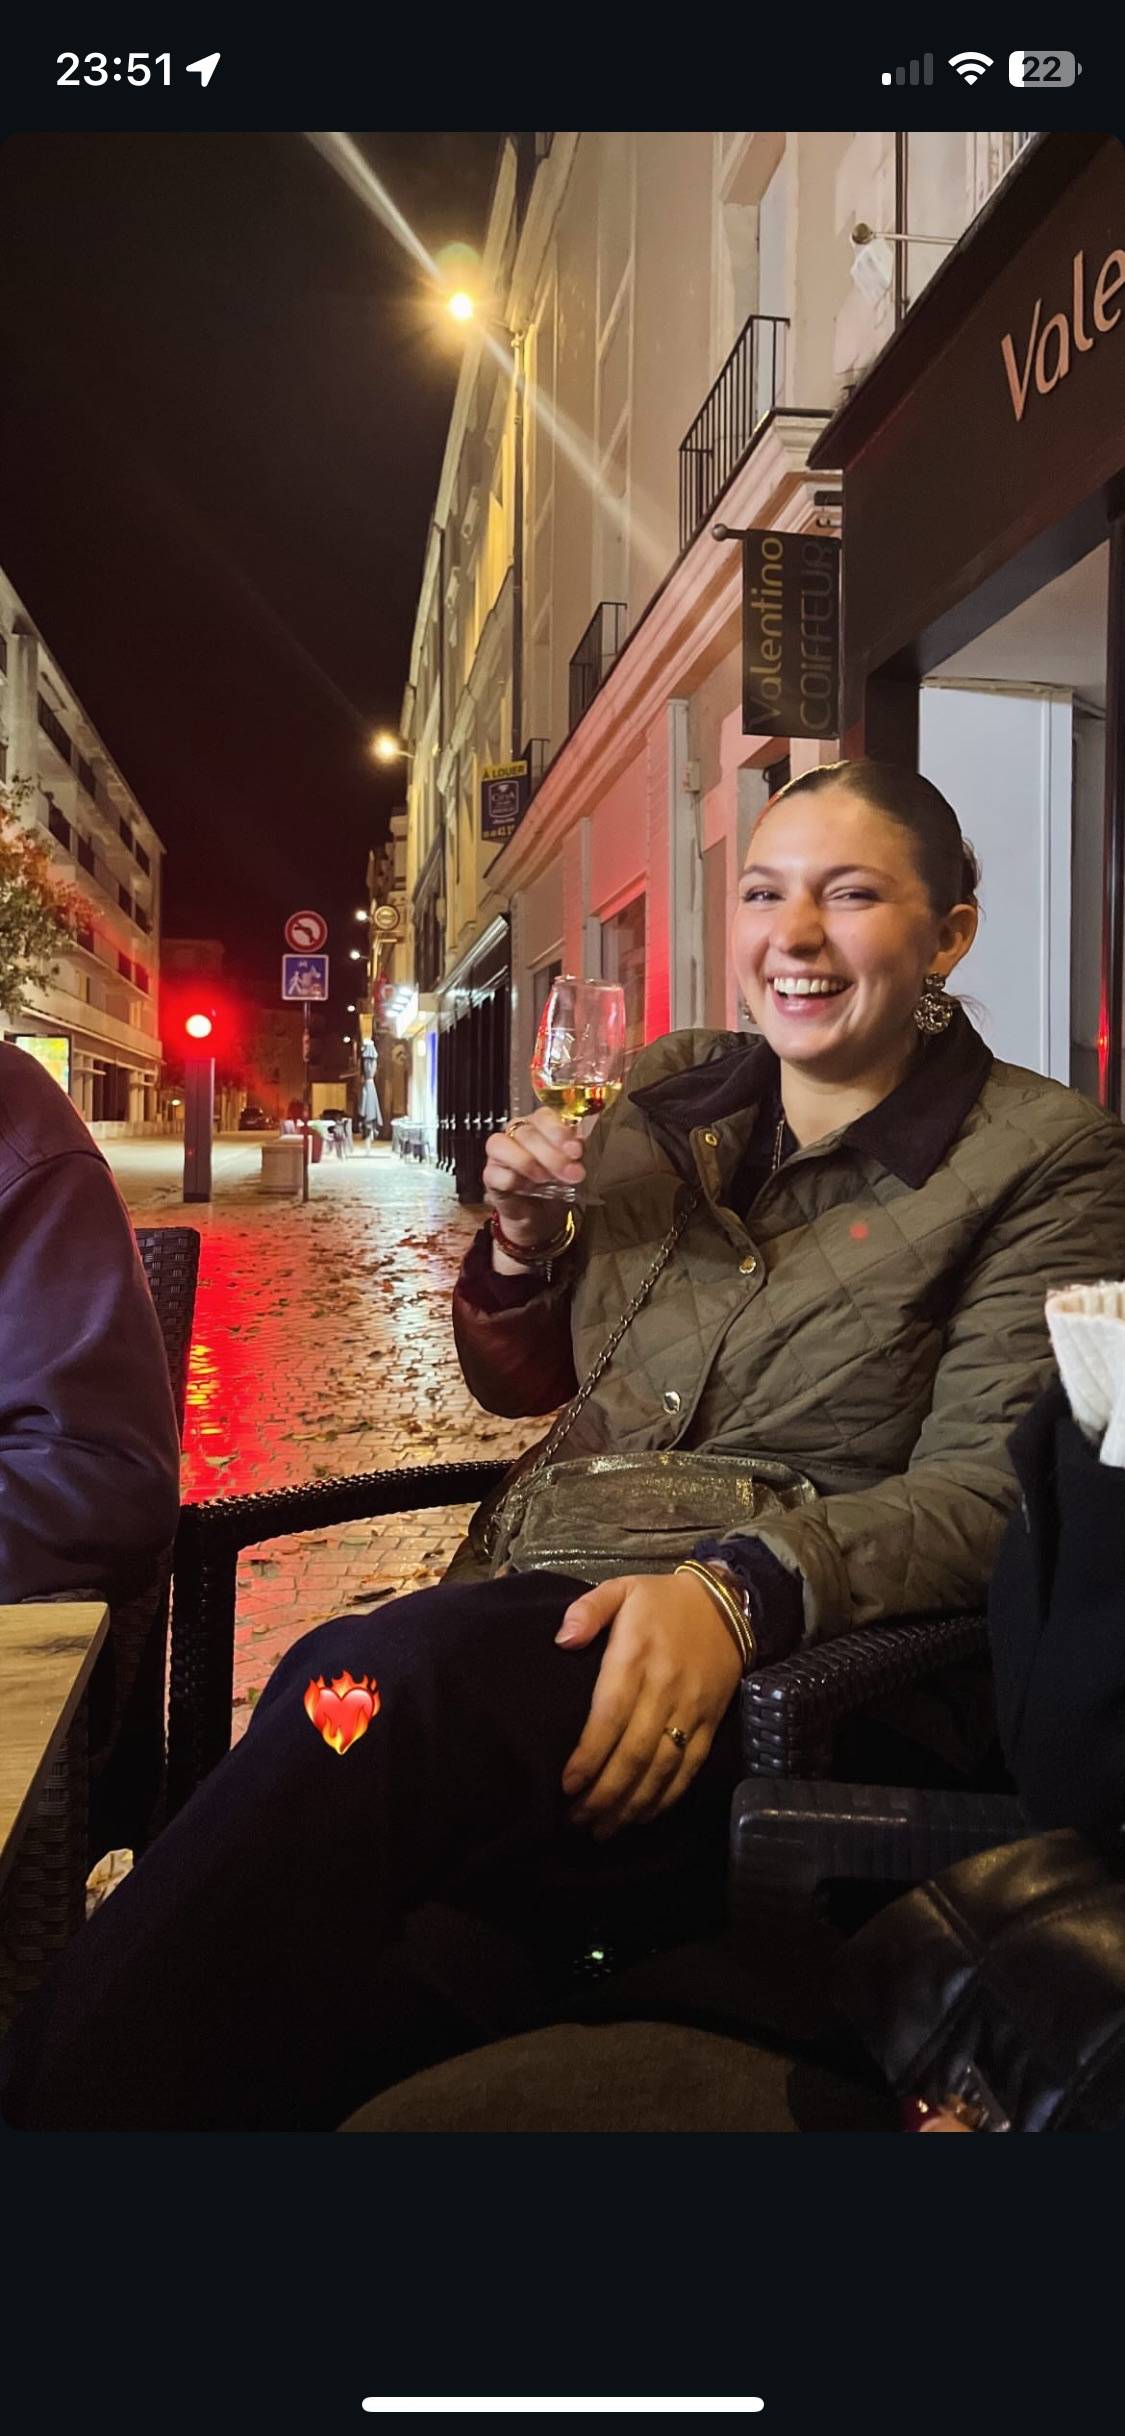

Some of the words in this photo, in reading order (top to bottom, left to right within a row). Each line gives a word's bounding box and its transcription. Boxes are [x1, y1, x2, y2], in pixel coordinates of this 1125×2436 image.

[1001, 249, 1125, 422] Vale
[749, 537, 784, 724] Valentino
[800, 541, 834, 731] COIFFEUR
[492, 765, 525, 778] LOUER
